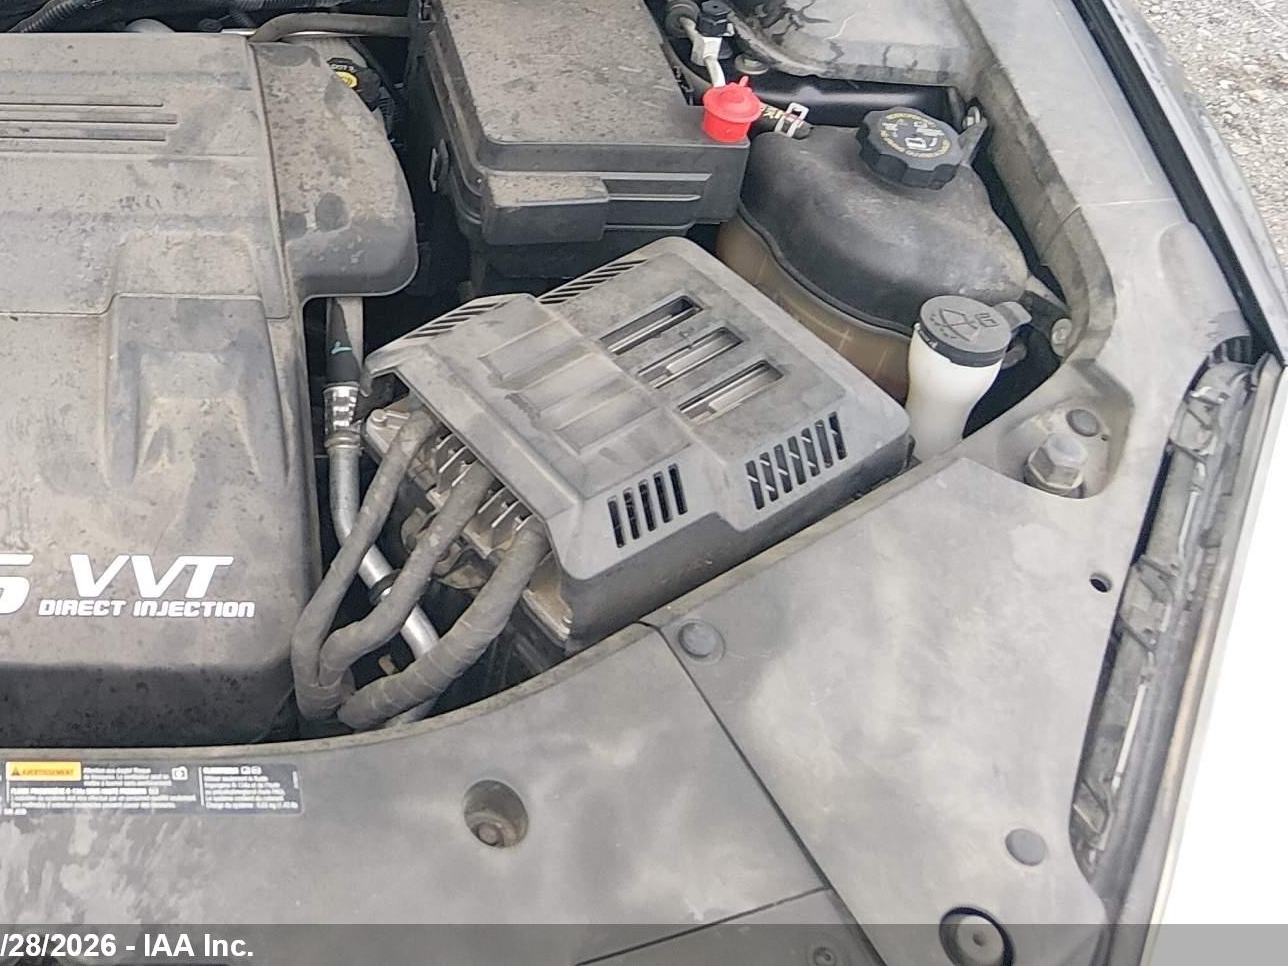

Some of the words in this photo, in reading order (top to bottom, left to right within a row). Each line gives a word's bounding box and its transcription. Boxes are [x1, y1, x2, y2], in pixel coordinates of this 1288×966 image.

[69, 554, 234, 599] VVT
[38, 599, 127, 617] DIRECT
[133, 600, 255, 618] INJECTION
